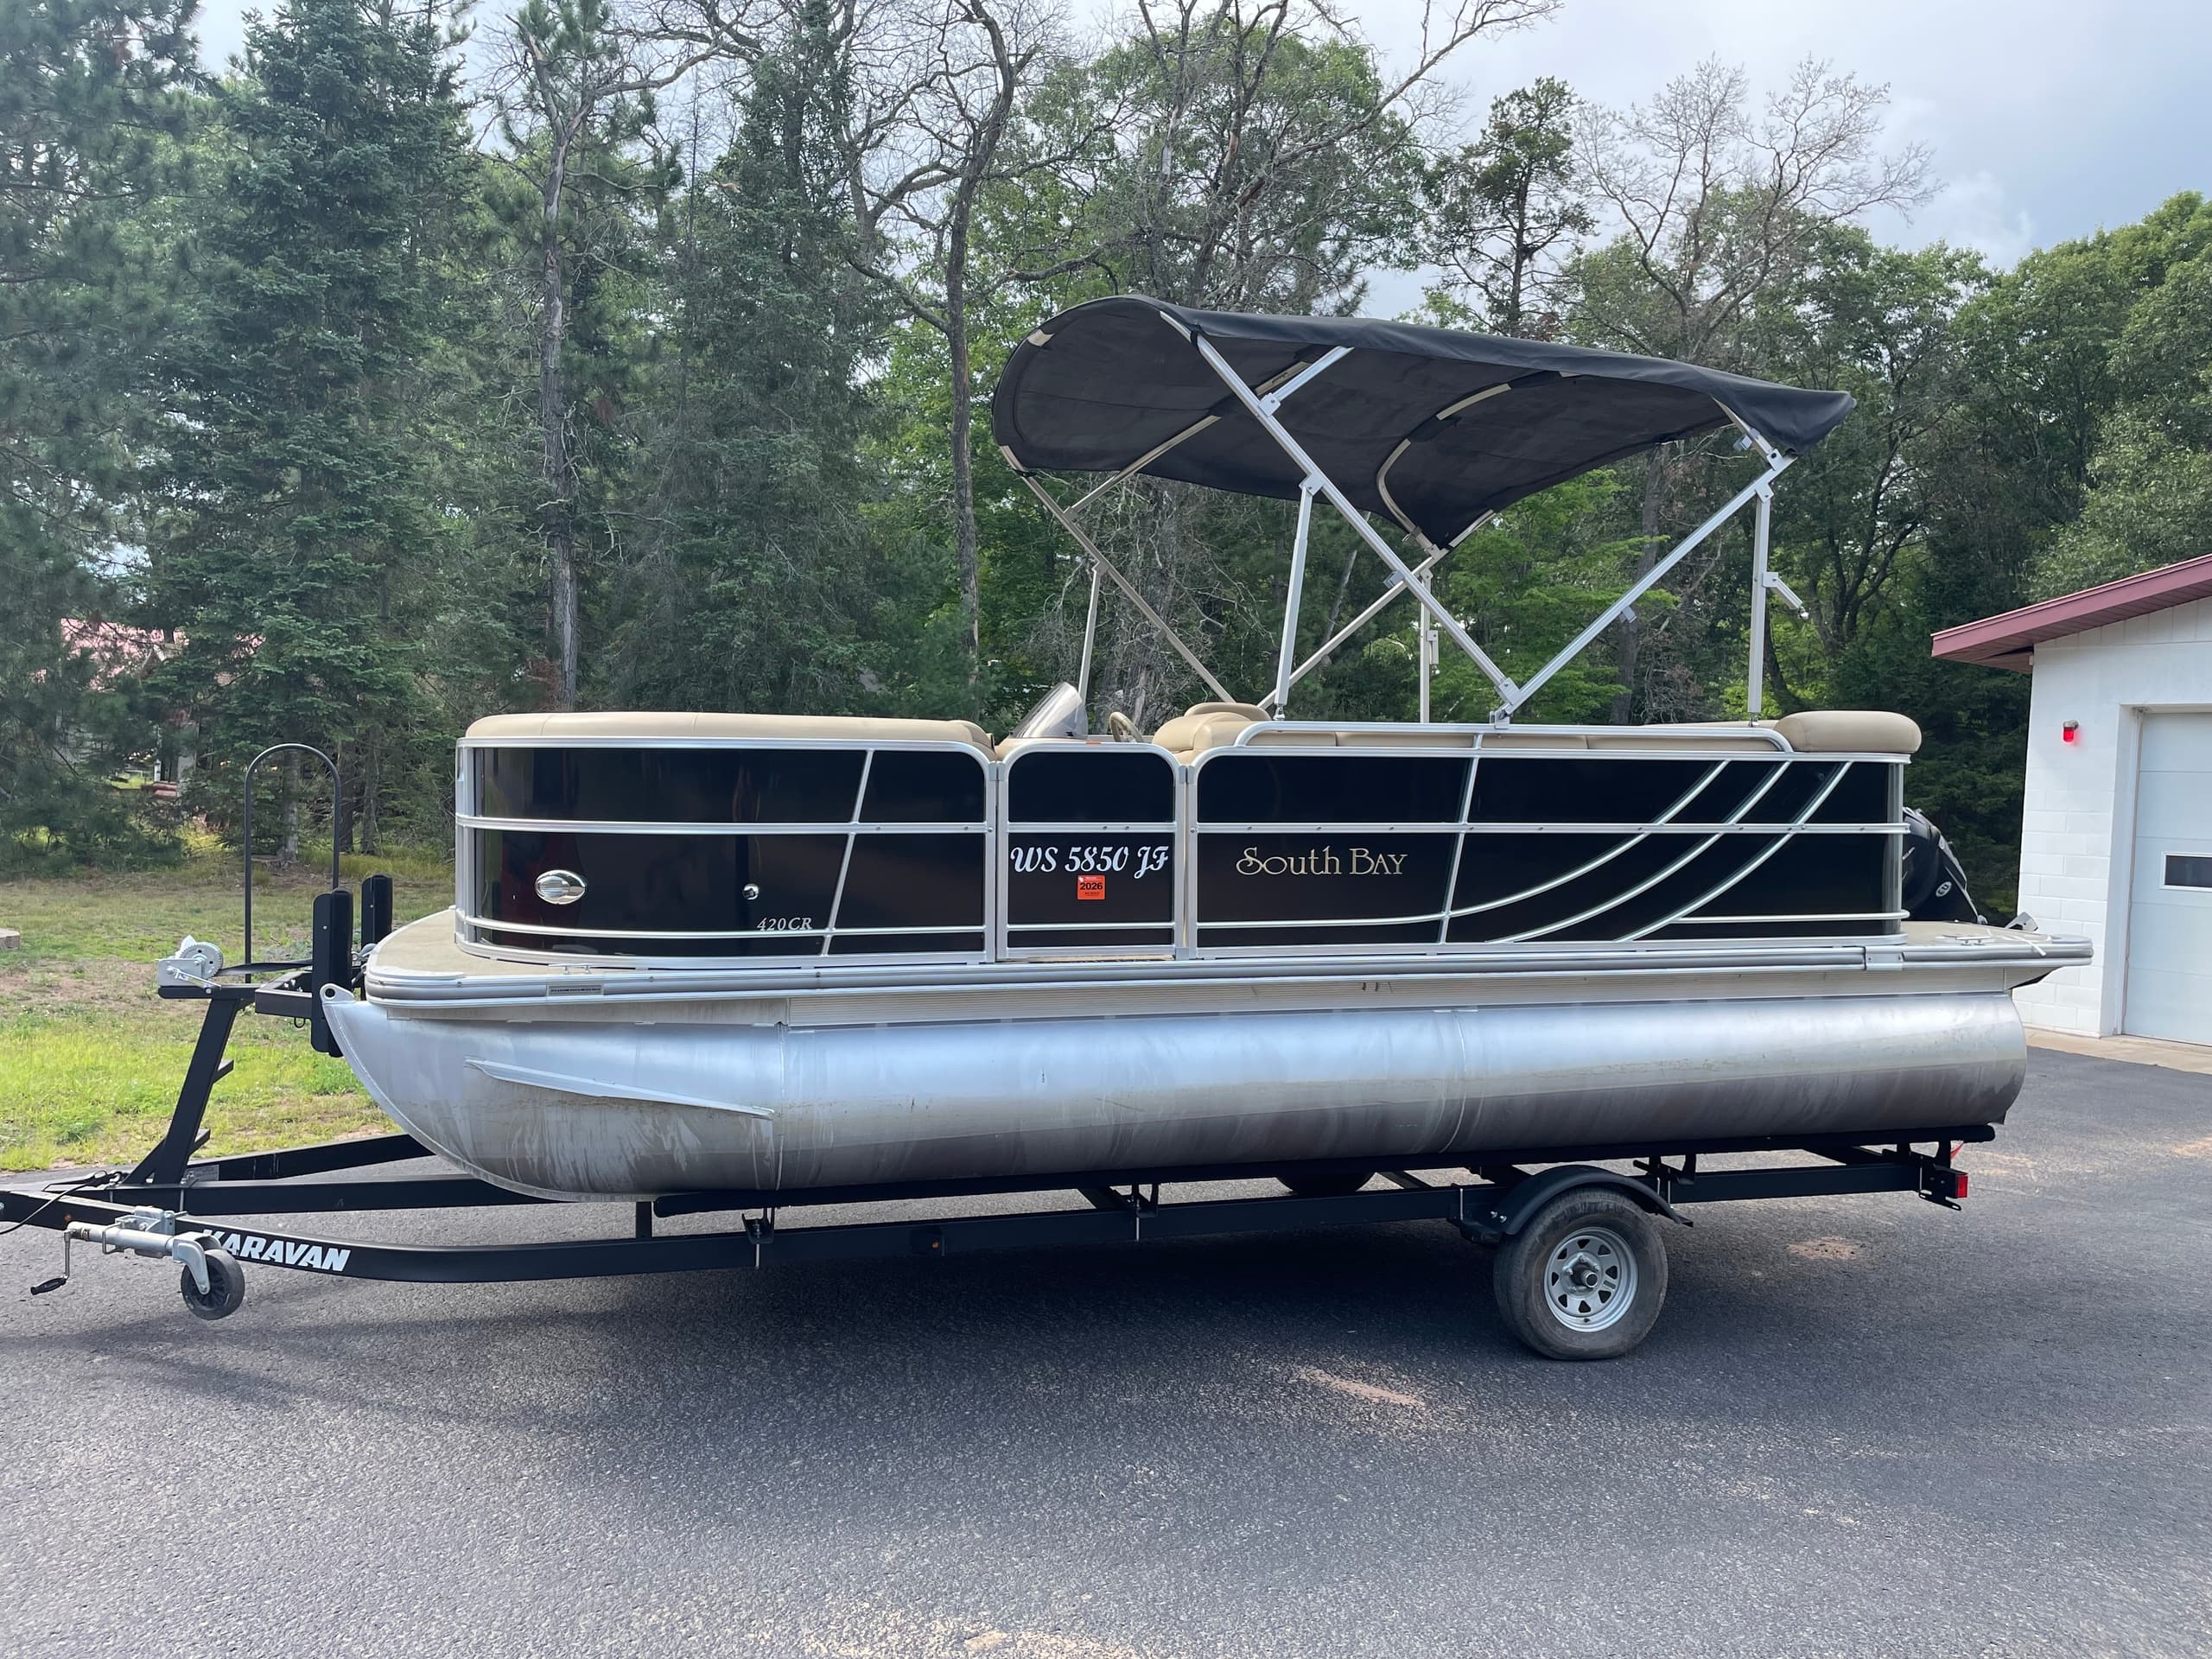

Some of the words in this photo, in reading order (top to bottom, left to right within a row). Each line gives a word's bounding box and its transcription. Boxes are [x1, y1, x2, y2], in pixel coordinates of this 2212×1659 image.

[1010, 847, 1058, 872] WS
[1065, 847, 1128, 872] 5850
[1134, 846, 1169, 879] JF
[1236, 846, 1342, 874] South
[756, 917, 813, 931] 420CR
